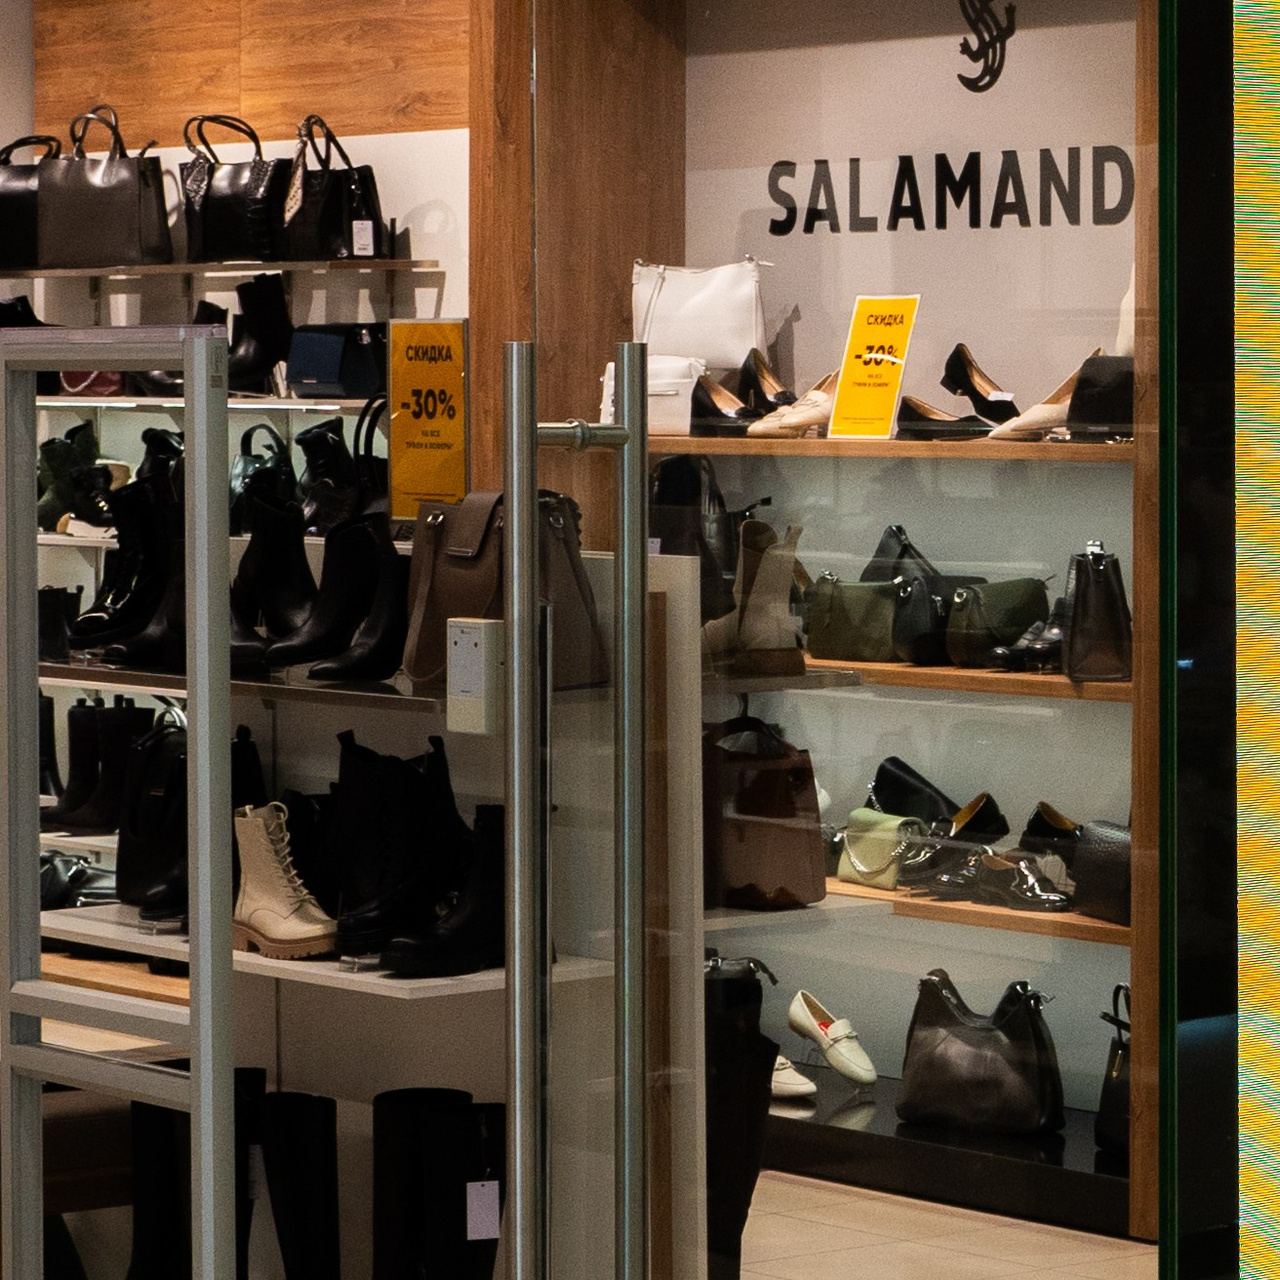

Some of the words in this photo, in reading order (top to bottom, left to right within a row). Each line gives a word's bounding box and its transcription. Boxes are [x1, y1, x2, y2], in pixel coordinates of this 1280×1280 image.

[767, 145, 1136, 236] SALAMAND
[866, 314, 904, 326] СКИДКА
[405, 344, 453, 364] СКИДКА
[854, 344, 899, 367] -30%
[400, 389, 457, 420] -30%
